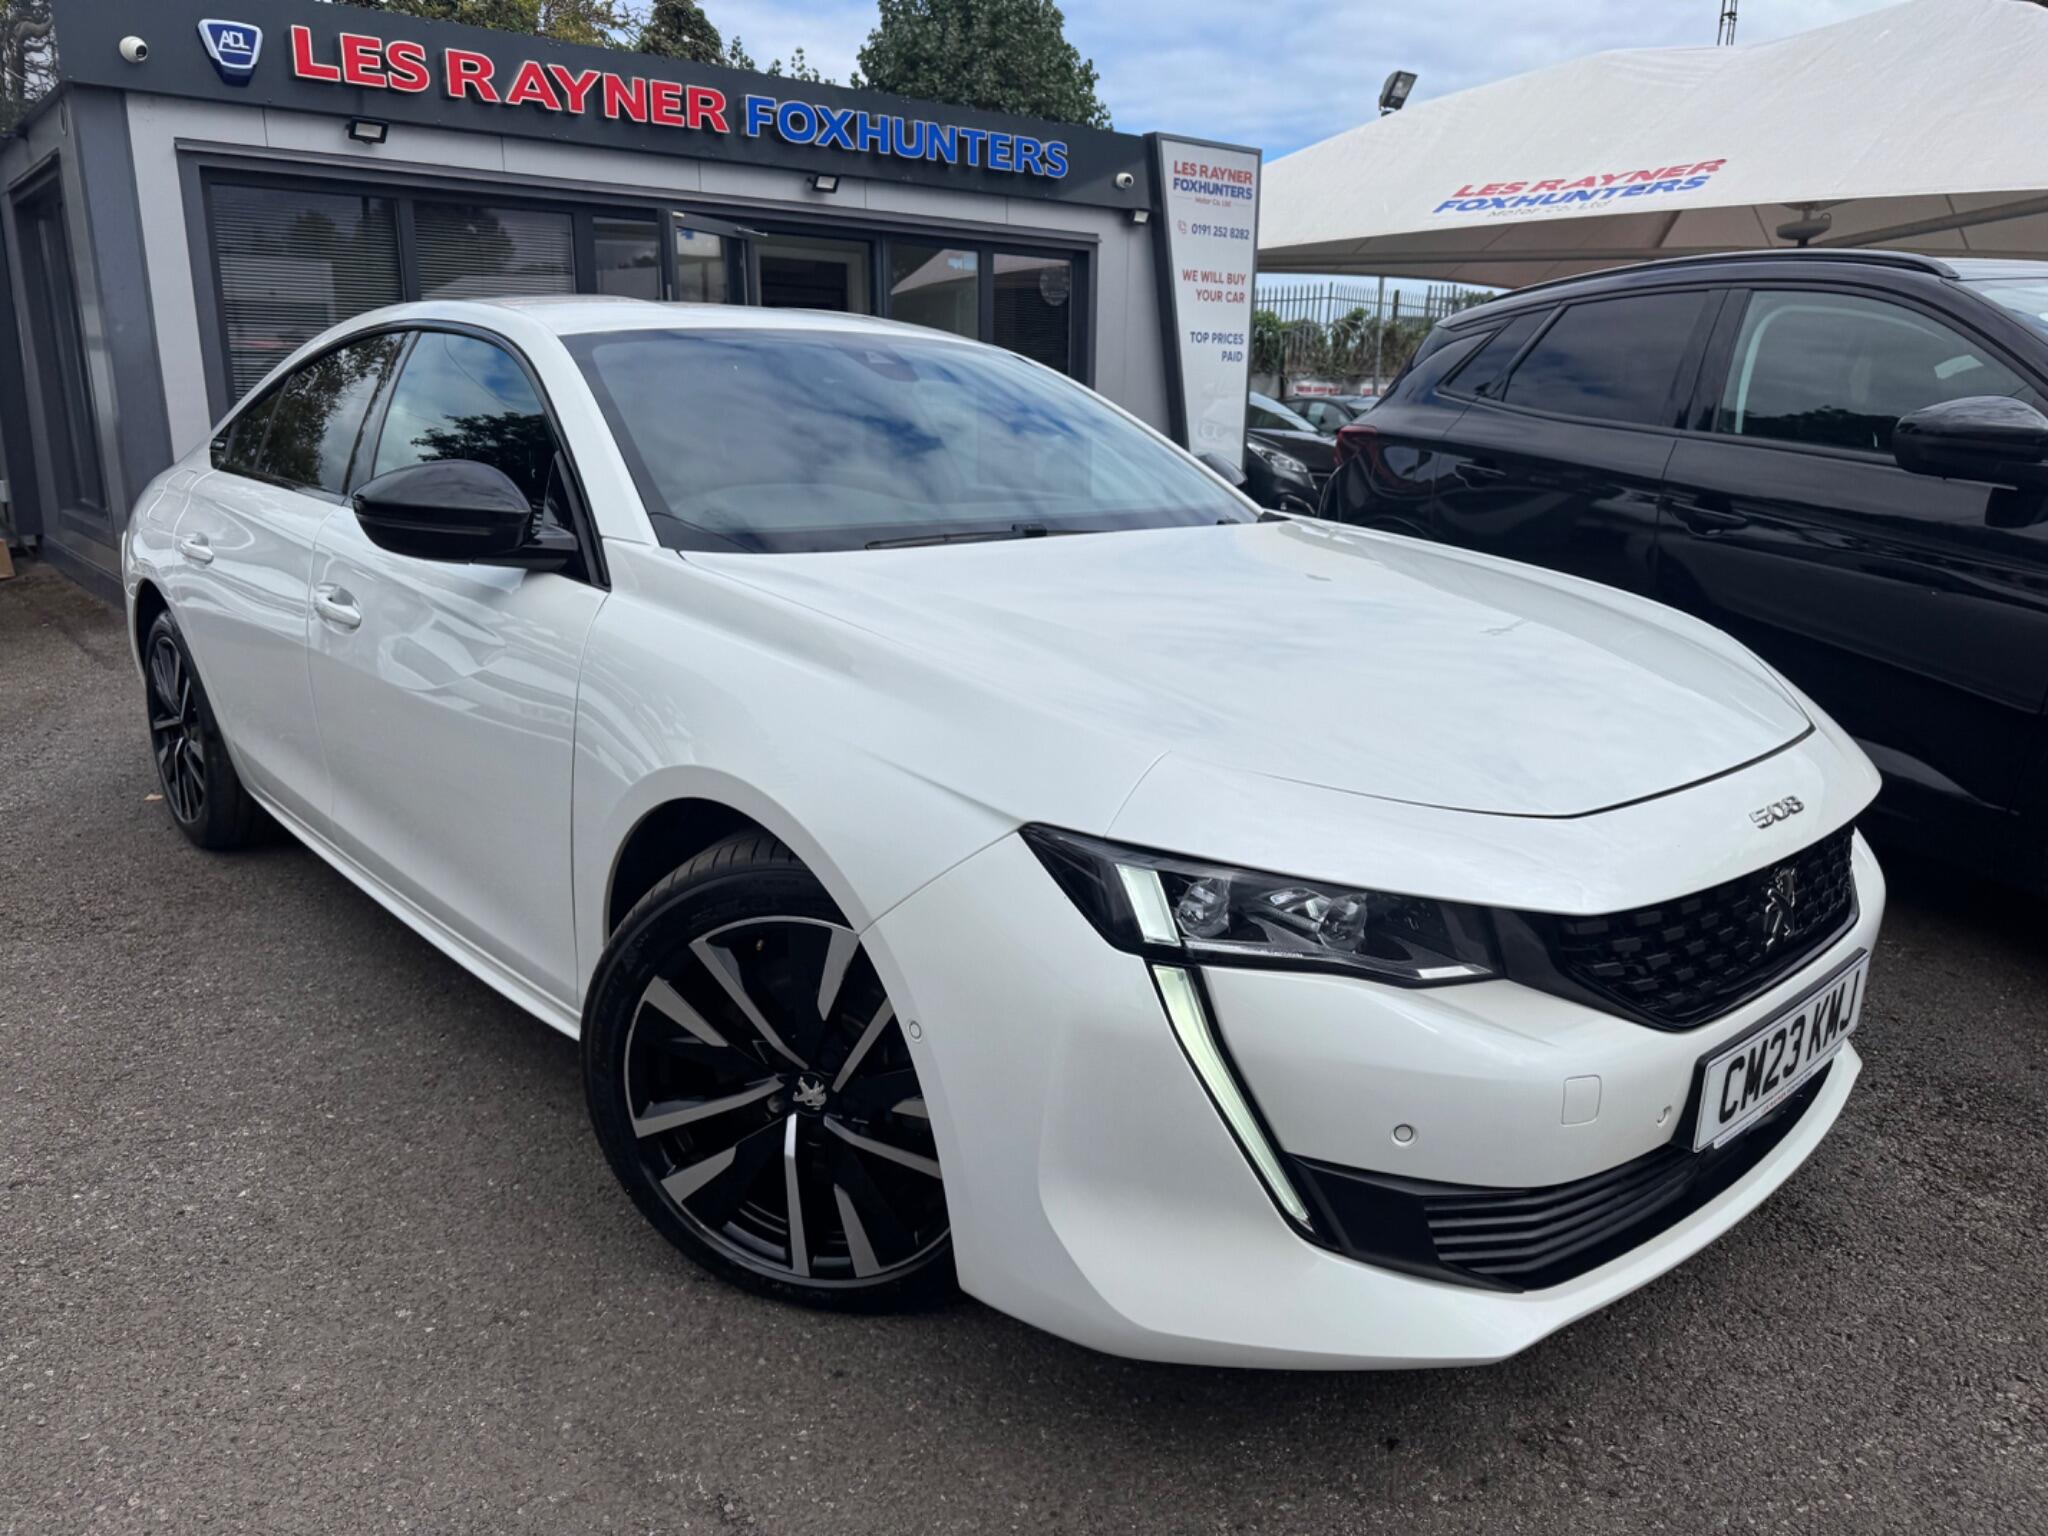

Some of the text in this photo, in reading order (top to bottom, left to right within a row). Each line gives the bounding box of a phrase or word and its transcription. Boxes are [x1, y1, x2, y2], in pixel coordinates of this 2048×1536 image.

[218, 30, 249, 49] ADL
[290, 24, 1069, 179] LES RAYNER FOXHUNTERS
[1174, 160, 1253, 185] LES RAYNER
[1452, 158, 1727, 198] LES RAYNER
[1173, 177, 1253, 200] FOXHUNTERS
[1432, 175, 1711, 214] FOXHUNTERS
[1191, 223, 1250, 240] 0191 252 8282
[1182, 270, 1246, 286] WE WILL BUY
[1196, 289, 1245, 304] YOUR CAR
[1190, 332, 1243, 345] TOP PRICES
[1221, 351, 1242, 362] PAID
[1748, 795, 1805, 829] 508
[1719, 1014, 1806, 1124] CM23
[1806, 970, 1860, 1061] KMJ
